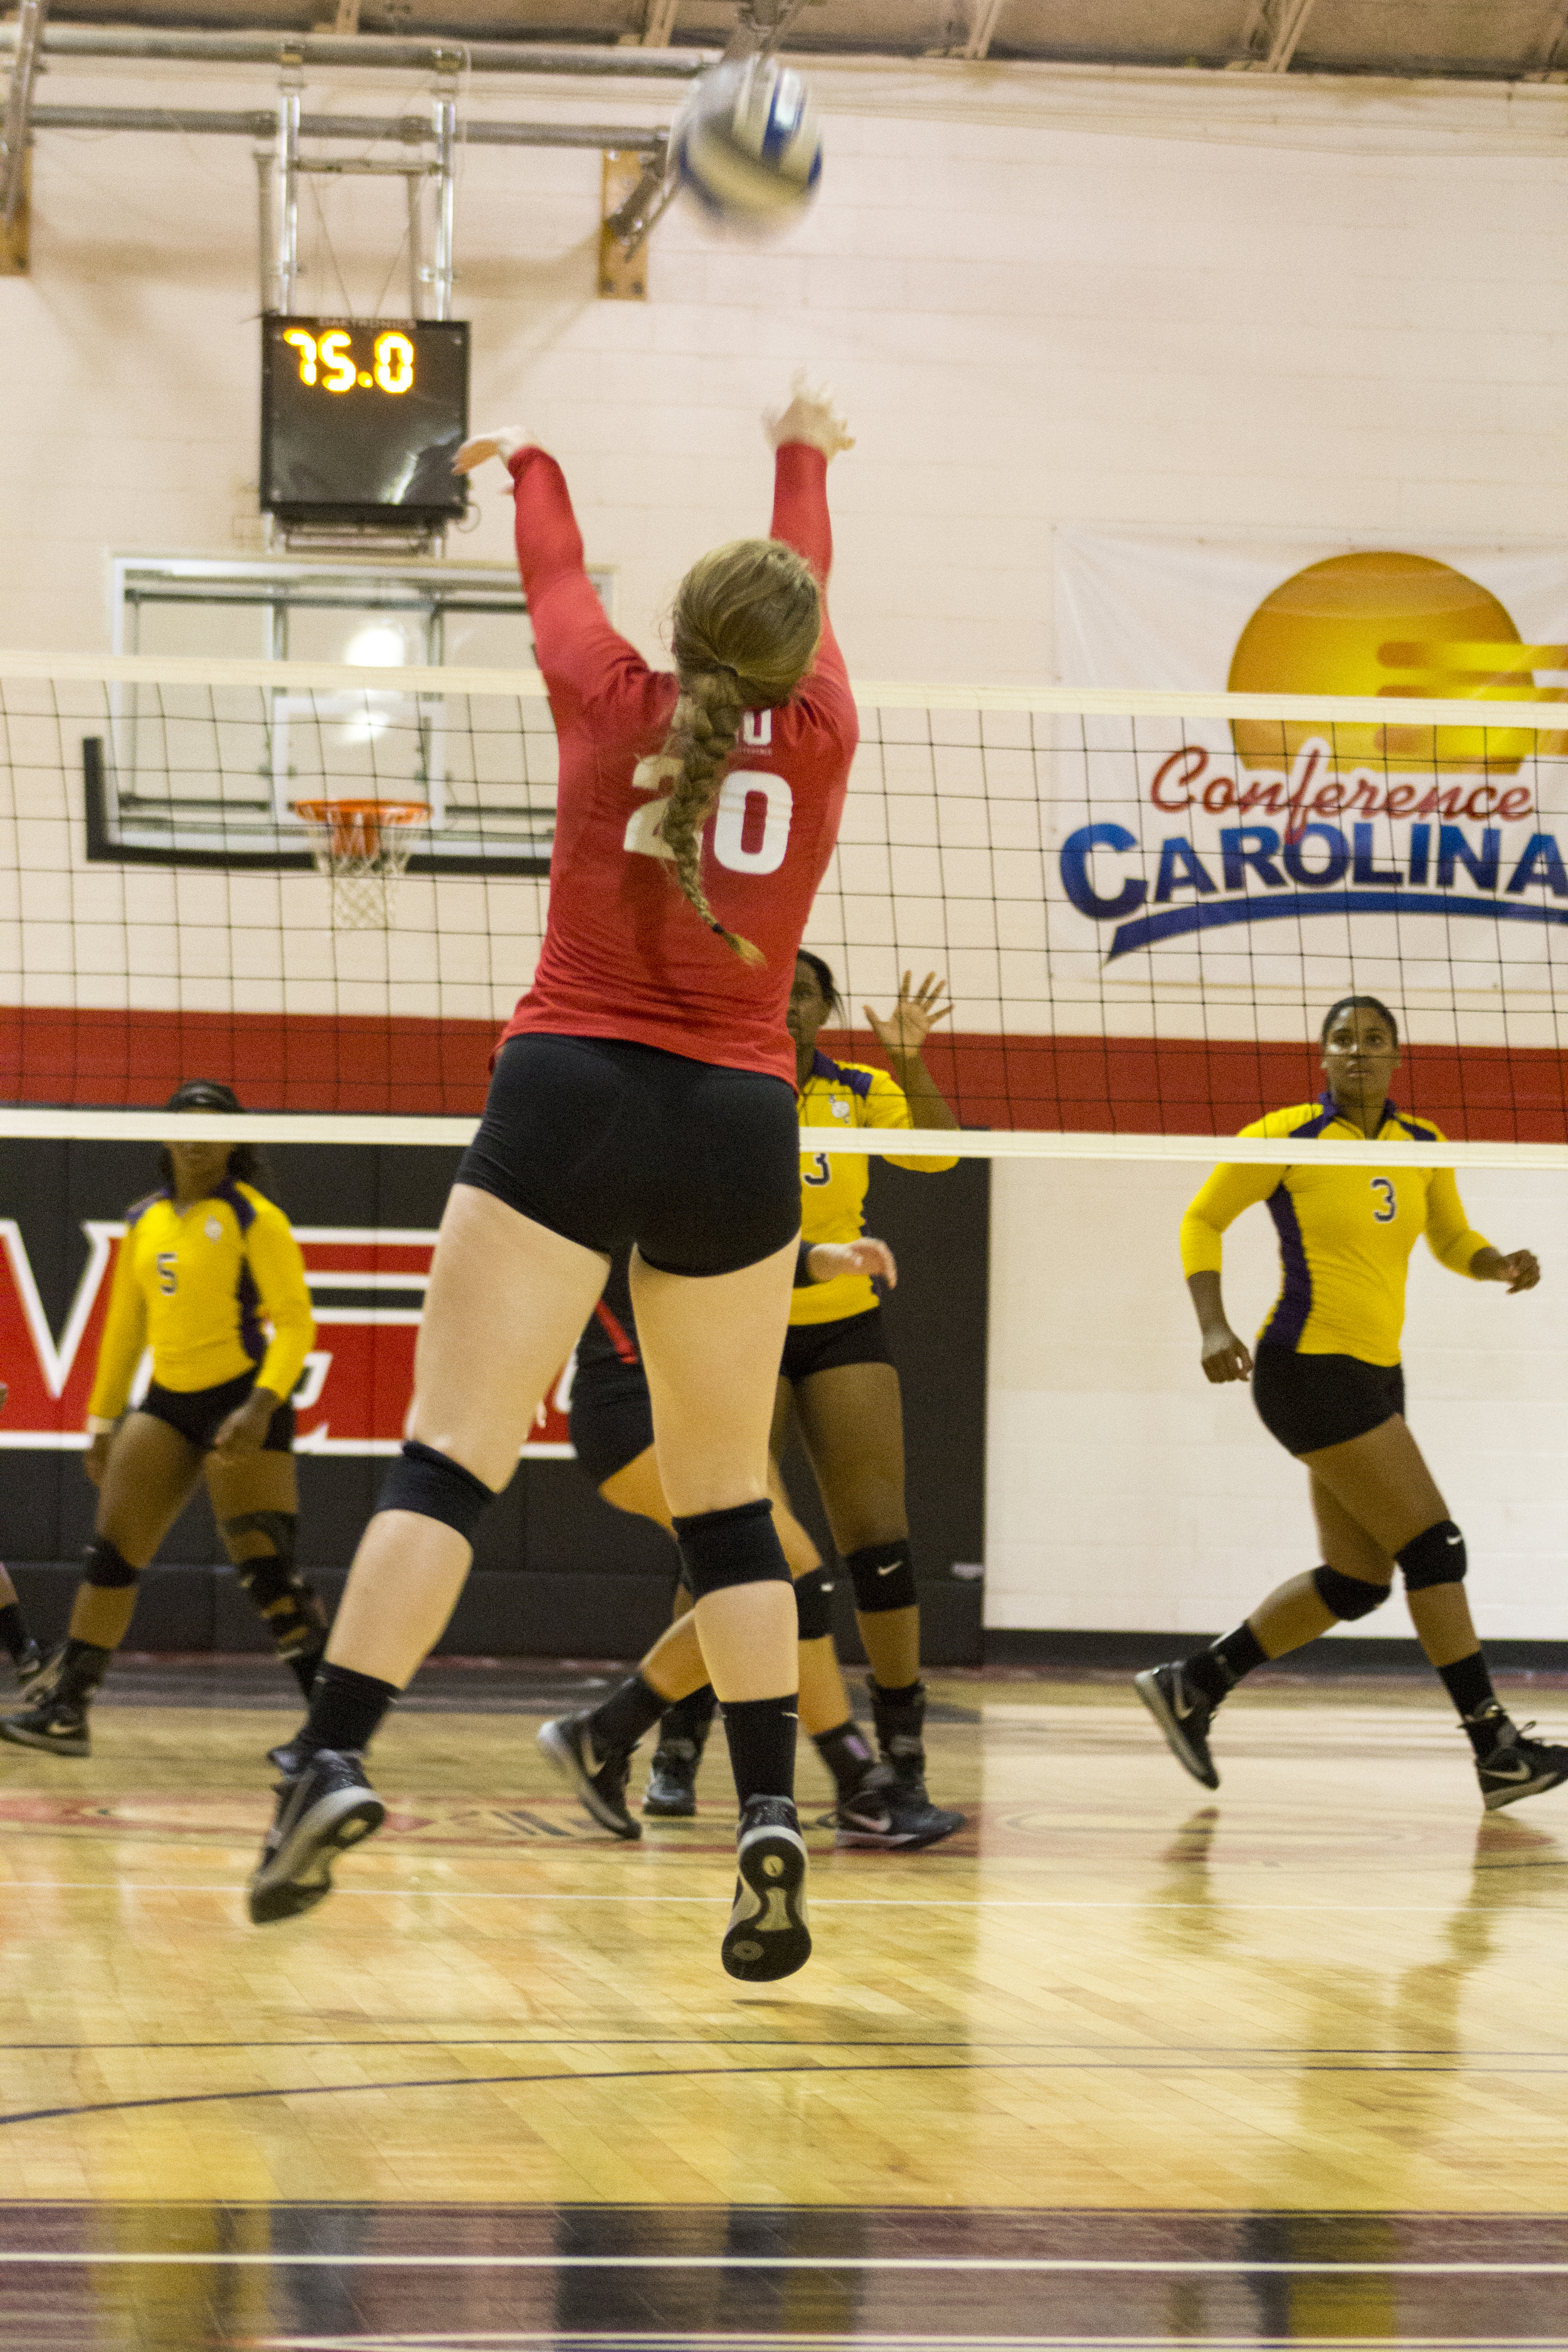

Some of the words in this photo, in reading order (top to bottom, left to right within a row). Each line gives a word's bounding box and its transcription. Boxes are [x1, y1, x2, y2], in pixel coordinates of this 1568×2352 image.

[283, 328, 414, 394] 75.0
[1151, 744, 1535, 845] Conference
[1370, 1177, 1397, 1224] 3
[156, 1251, 179, 1296] 5
